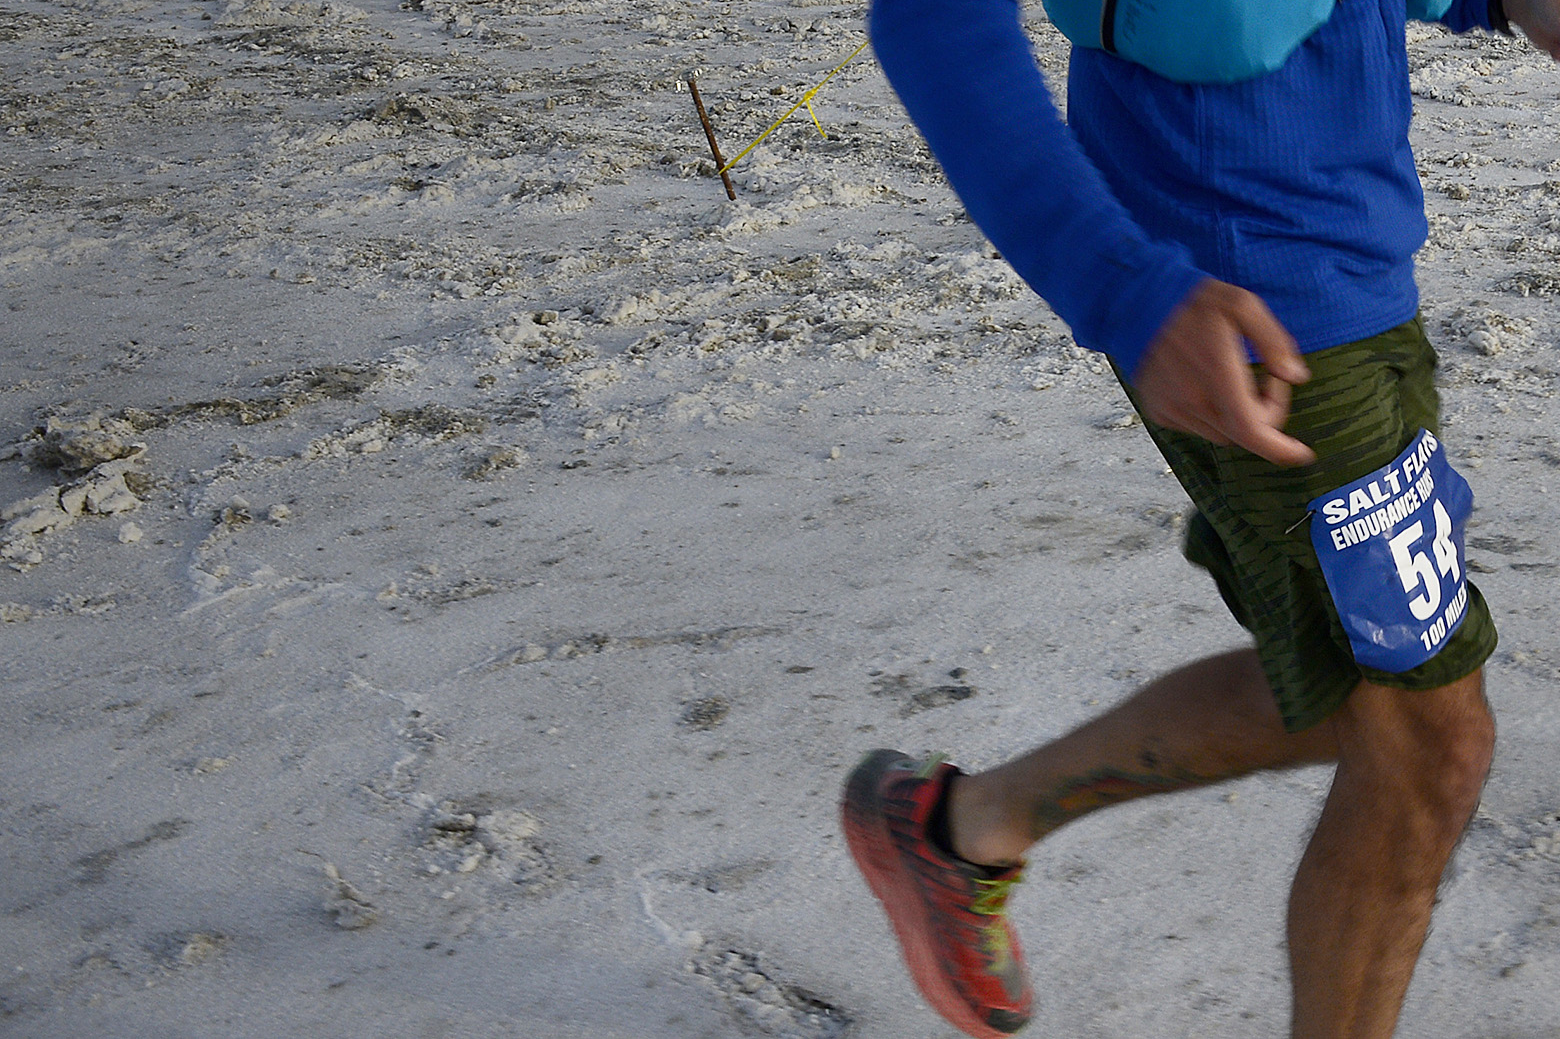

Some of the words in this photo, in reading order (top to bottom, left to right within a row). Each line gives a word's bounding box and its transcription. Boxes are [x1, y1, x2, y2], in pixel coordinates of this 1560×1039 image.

[1322, 469, 1402, 525] SALT
[1402, 429, 1438, 483] FLATS
[1330, 486, 1419, 551] ENDURANCE
[1389, 498, 1461, 621] 54
[1420, 616, 1446, 651] 100
